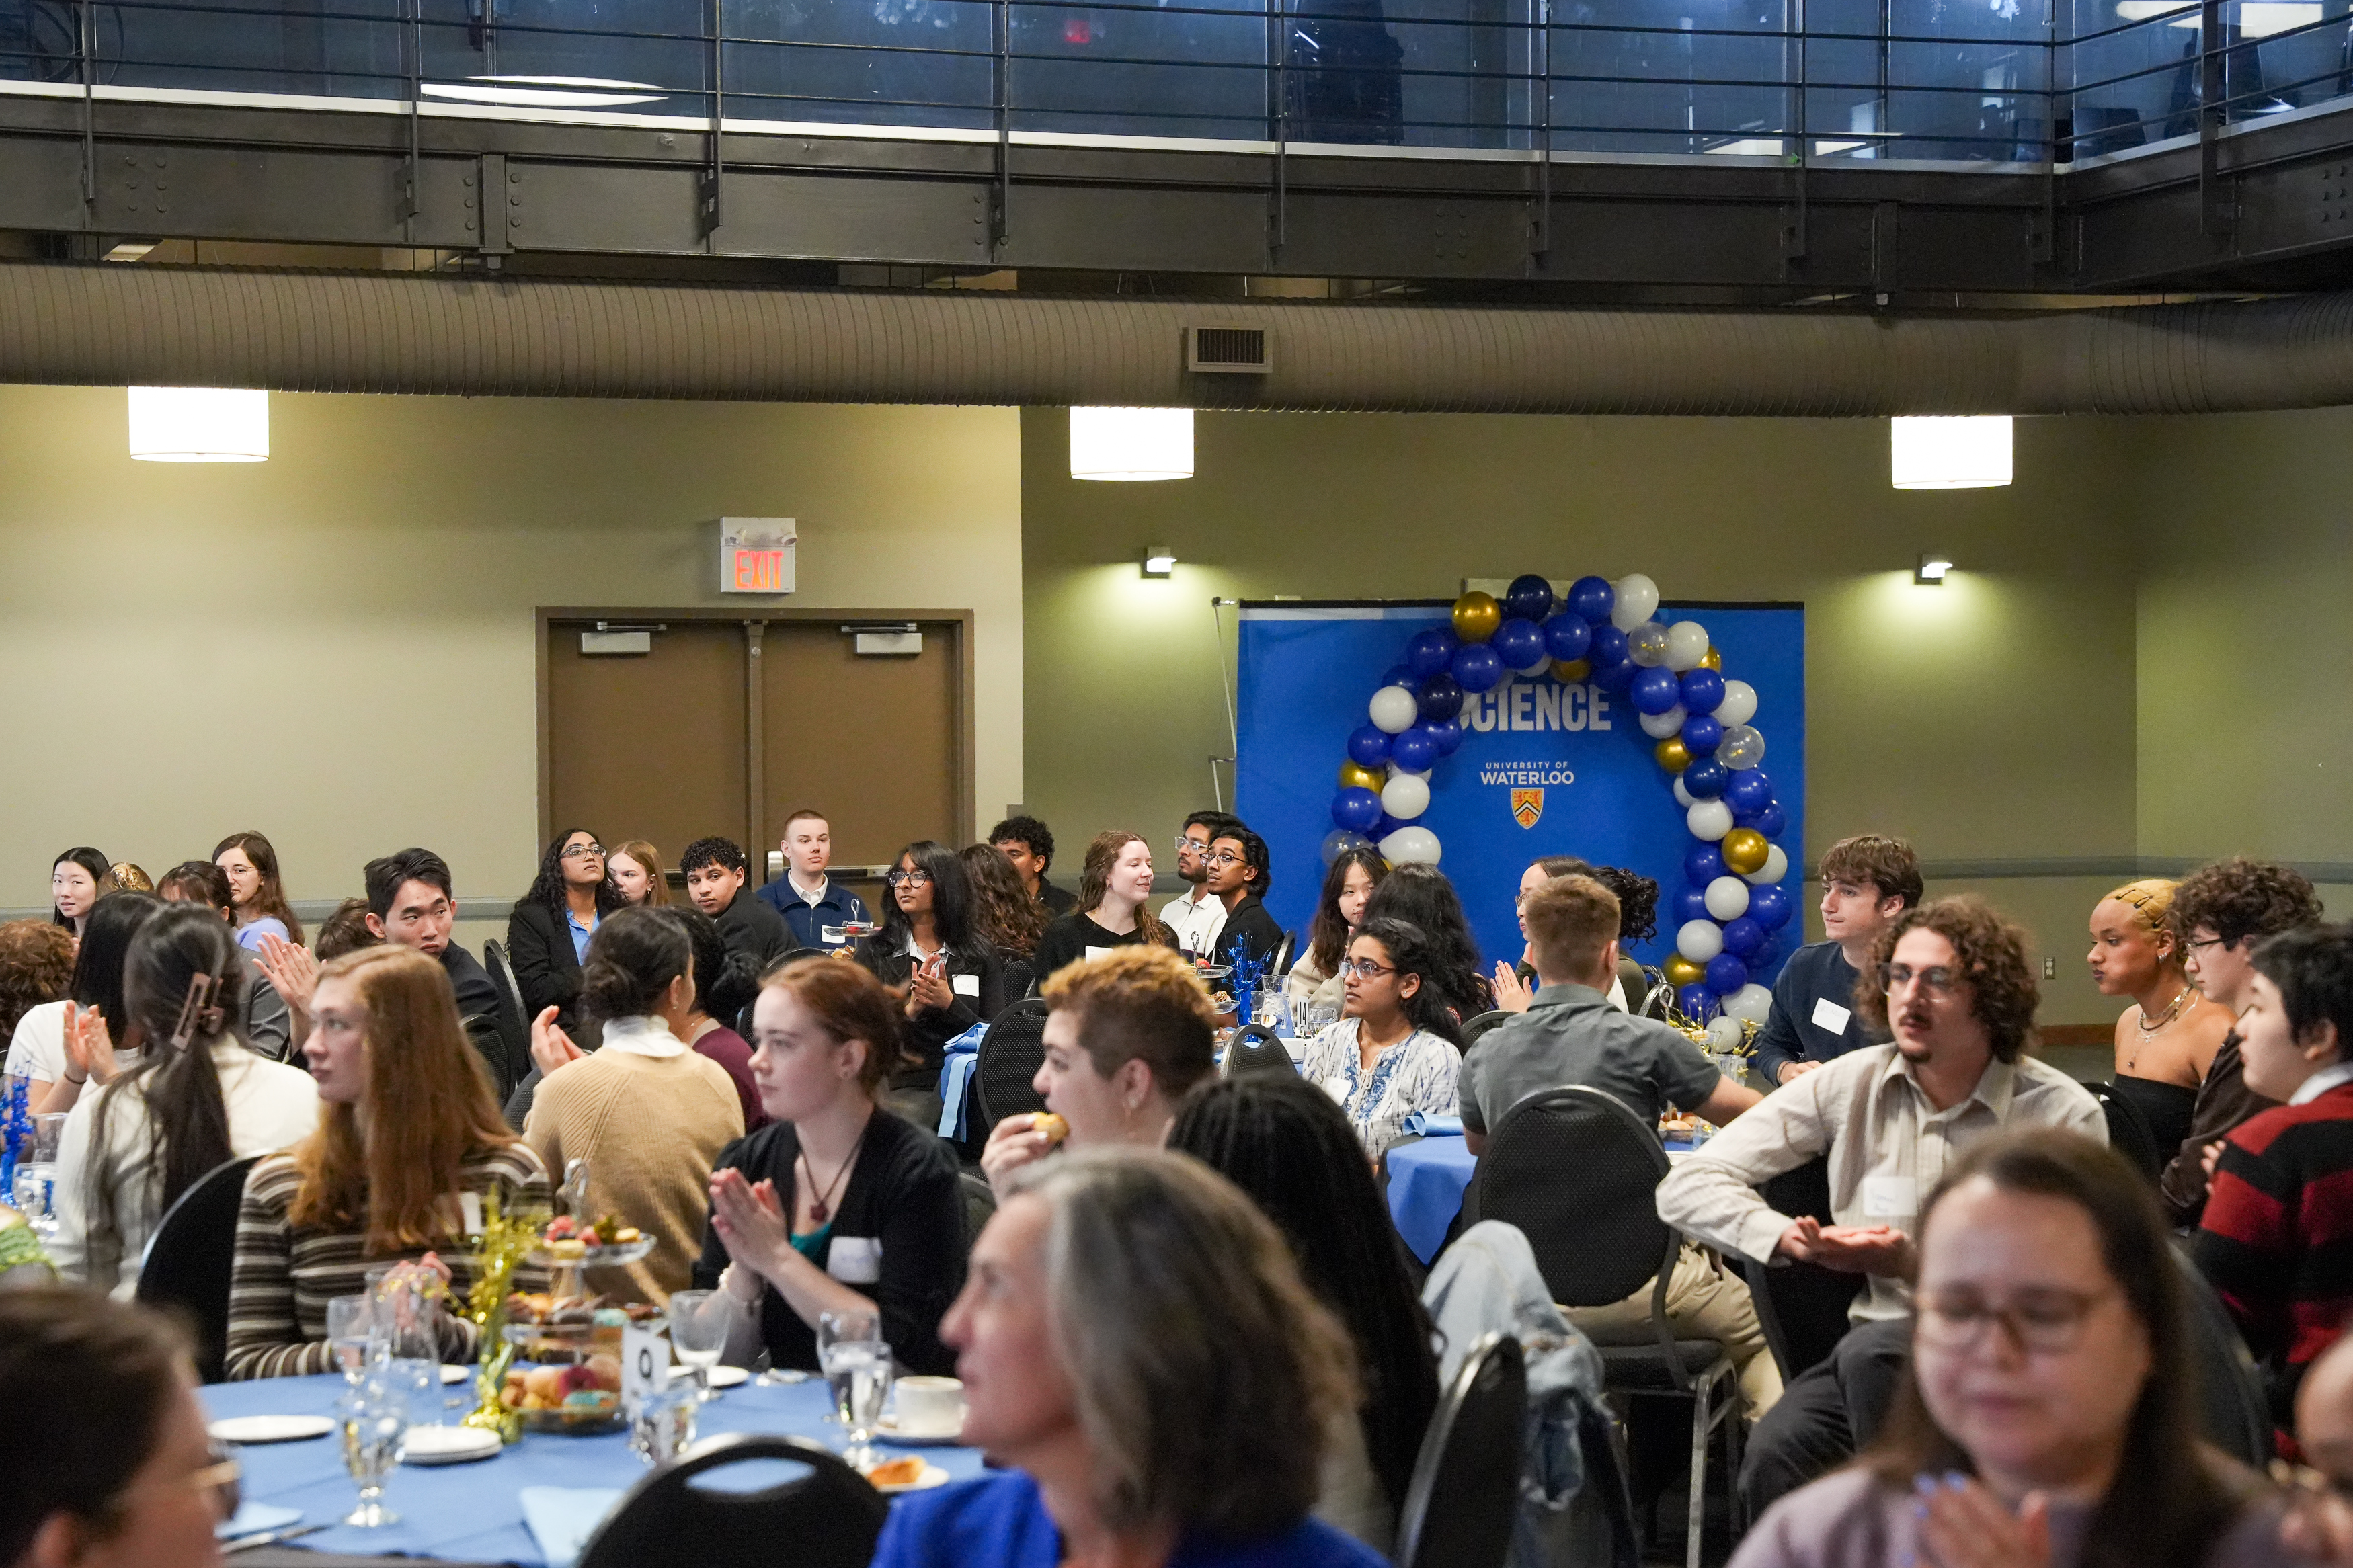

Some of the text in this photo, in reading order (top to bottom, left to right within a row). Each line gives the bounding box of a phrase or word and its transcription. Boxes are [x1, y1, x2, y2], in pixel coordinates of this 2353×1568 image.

[735, 550, 784, 589] EXIT
[1486, 761, 1550, 770] UNIVERSITY
[1480, 771, 1574, 785] WATERLOO
[1300, 1001, 1307, 1025] 14
